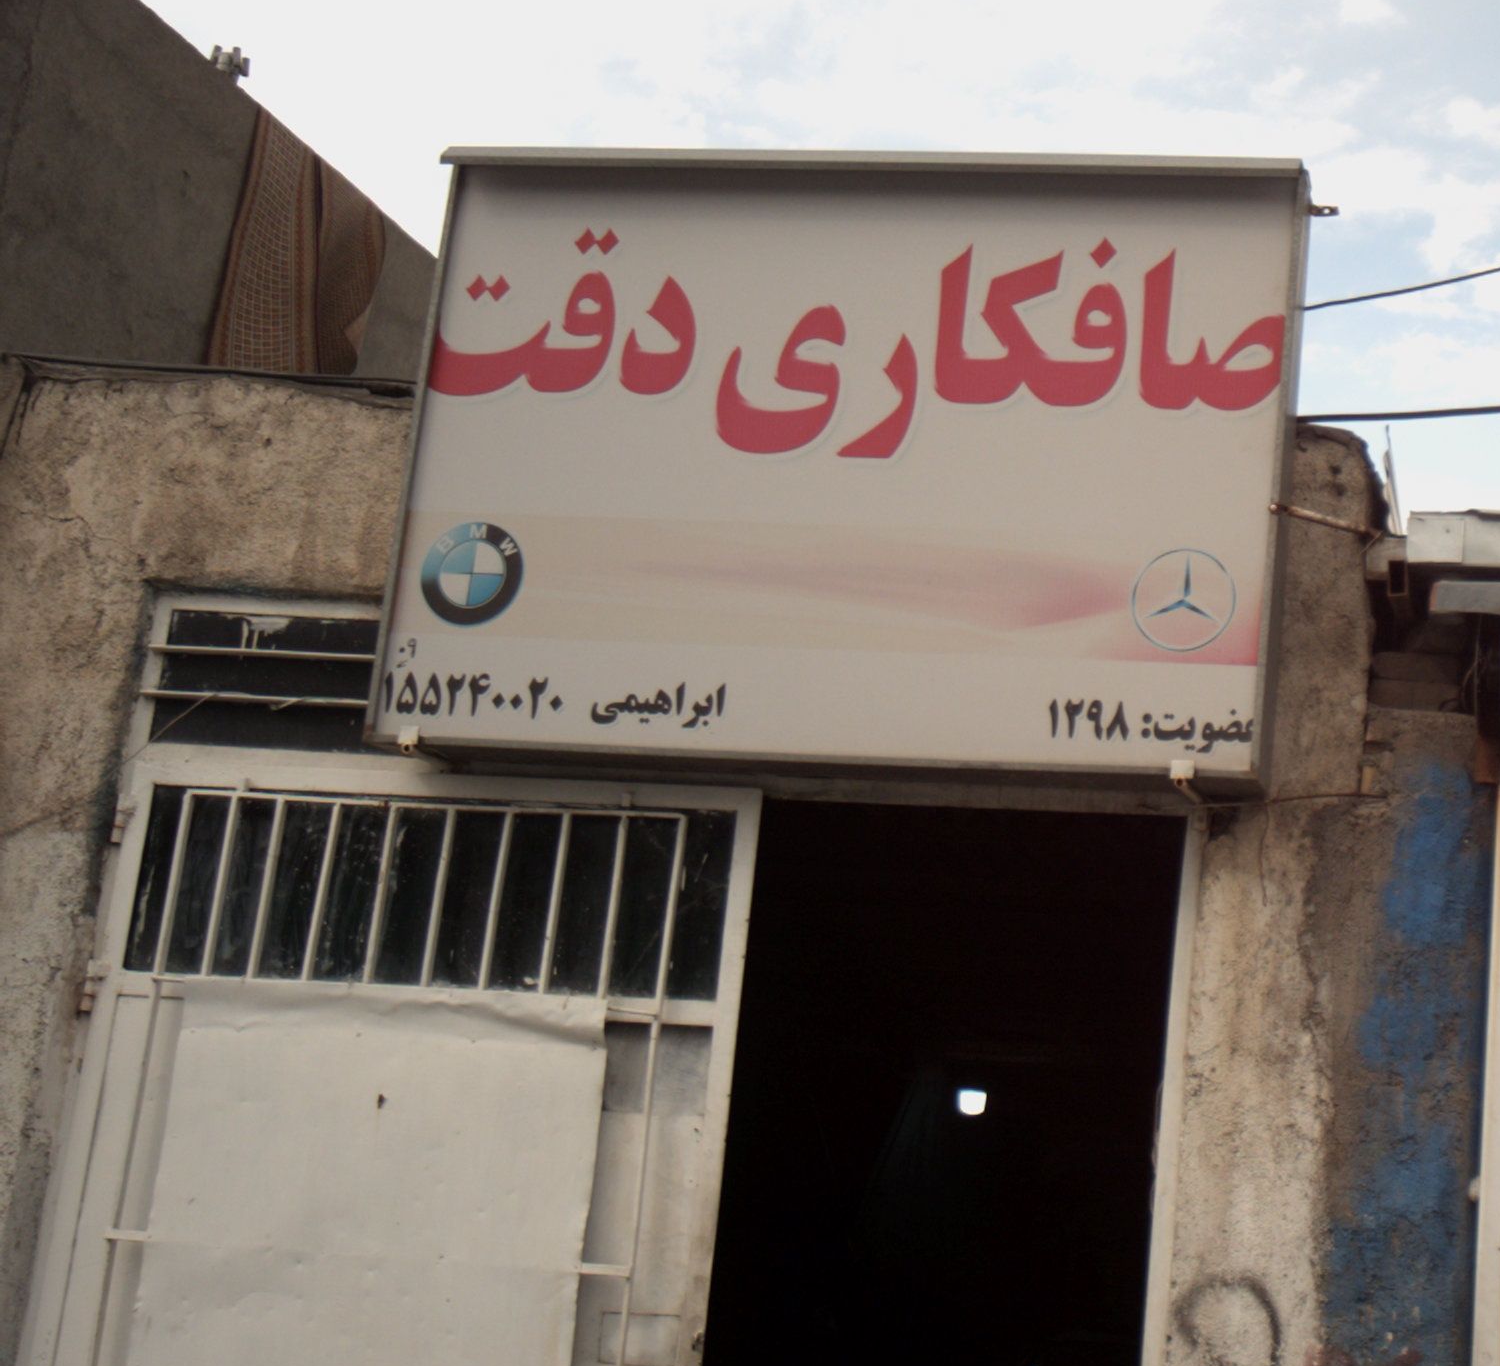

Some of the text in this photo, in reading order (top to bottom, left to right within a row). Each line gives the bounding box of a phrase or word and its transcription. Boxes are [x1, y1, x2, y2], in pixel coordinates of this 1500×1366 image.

[428, 227, 1286, 459] صافکاری دقت
[436, 523, 519, 557] BMW
[384, 671, 727, 729] ابراهیمی ۱۵۵۲۴۰۰۲۰
[1048, 698, 1130, 742] ۱۲۹۸
